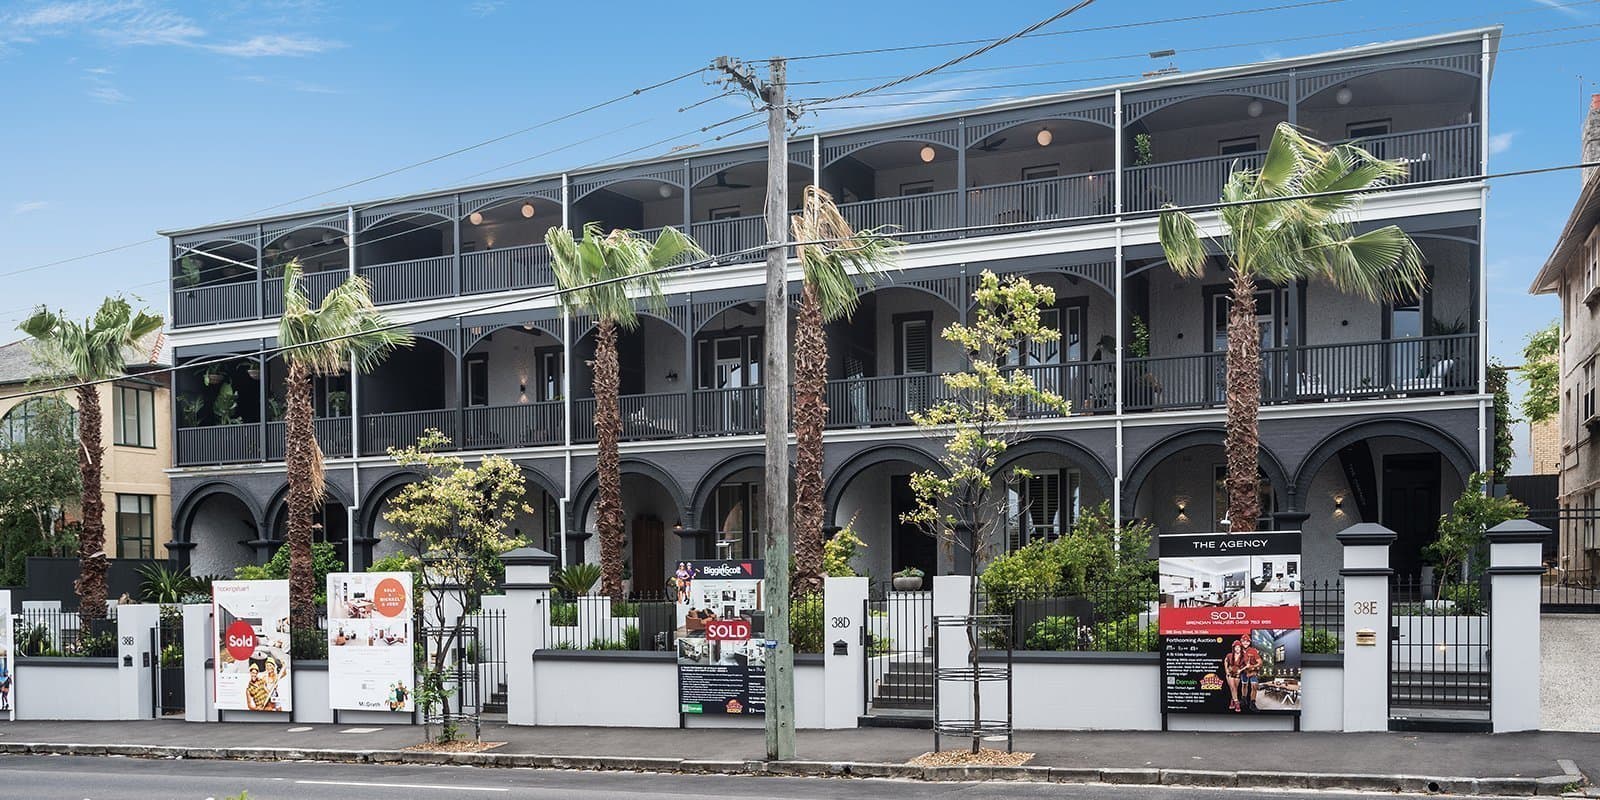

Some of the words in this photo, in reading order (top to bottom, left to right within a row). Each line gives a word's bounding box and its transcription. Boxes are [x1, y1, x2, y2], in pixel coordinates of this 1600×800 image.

[1193, 541, 1216, 549] THE
[1219, 539, 1268, 548] AGENCY
[1353, 601, 1378, 615] 38E
[1210, 611, 1246, 620] SOLD
[831, 616, 851, 629] 38D
[708, 624, 748, 638] SOLD
[121, 636, 135, 646] 38B
[229, 635, 253, 647] Sold
